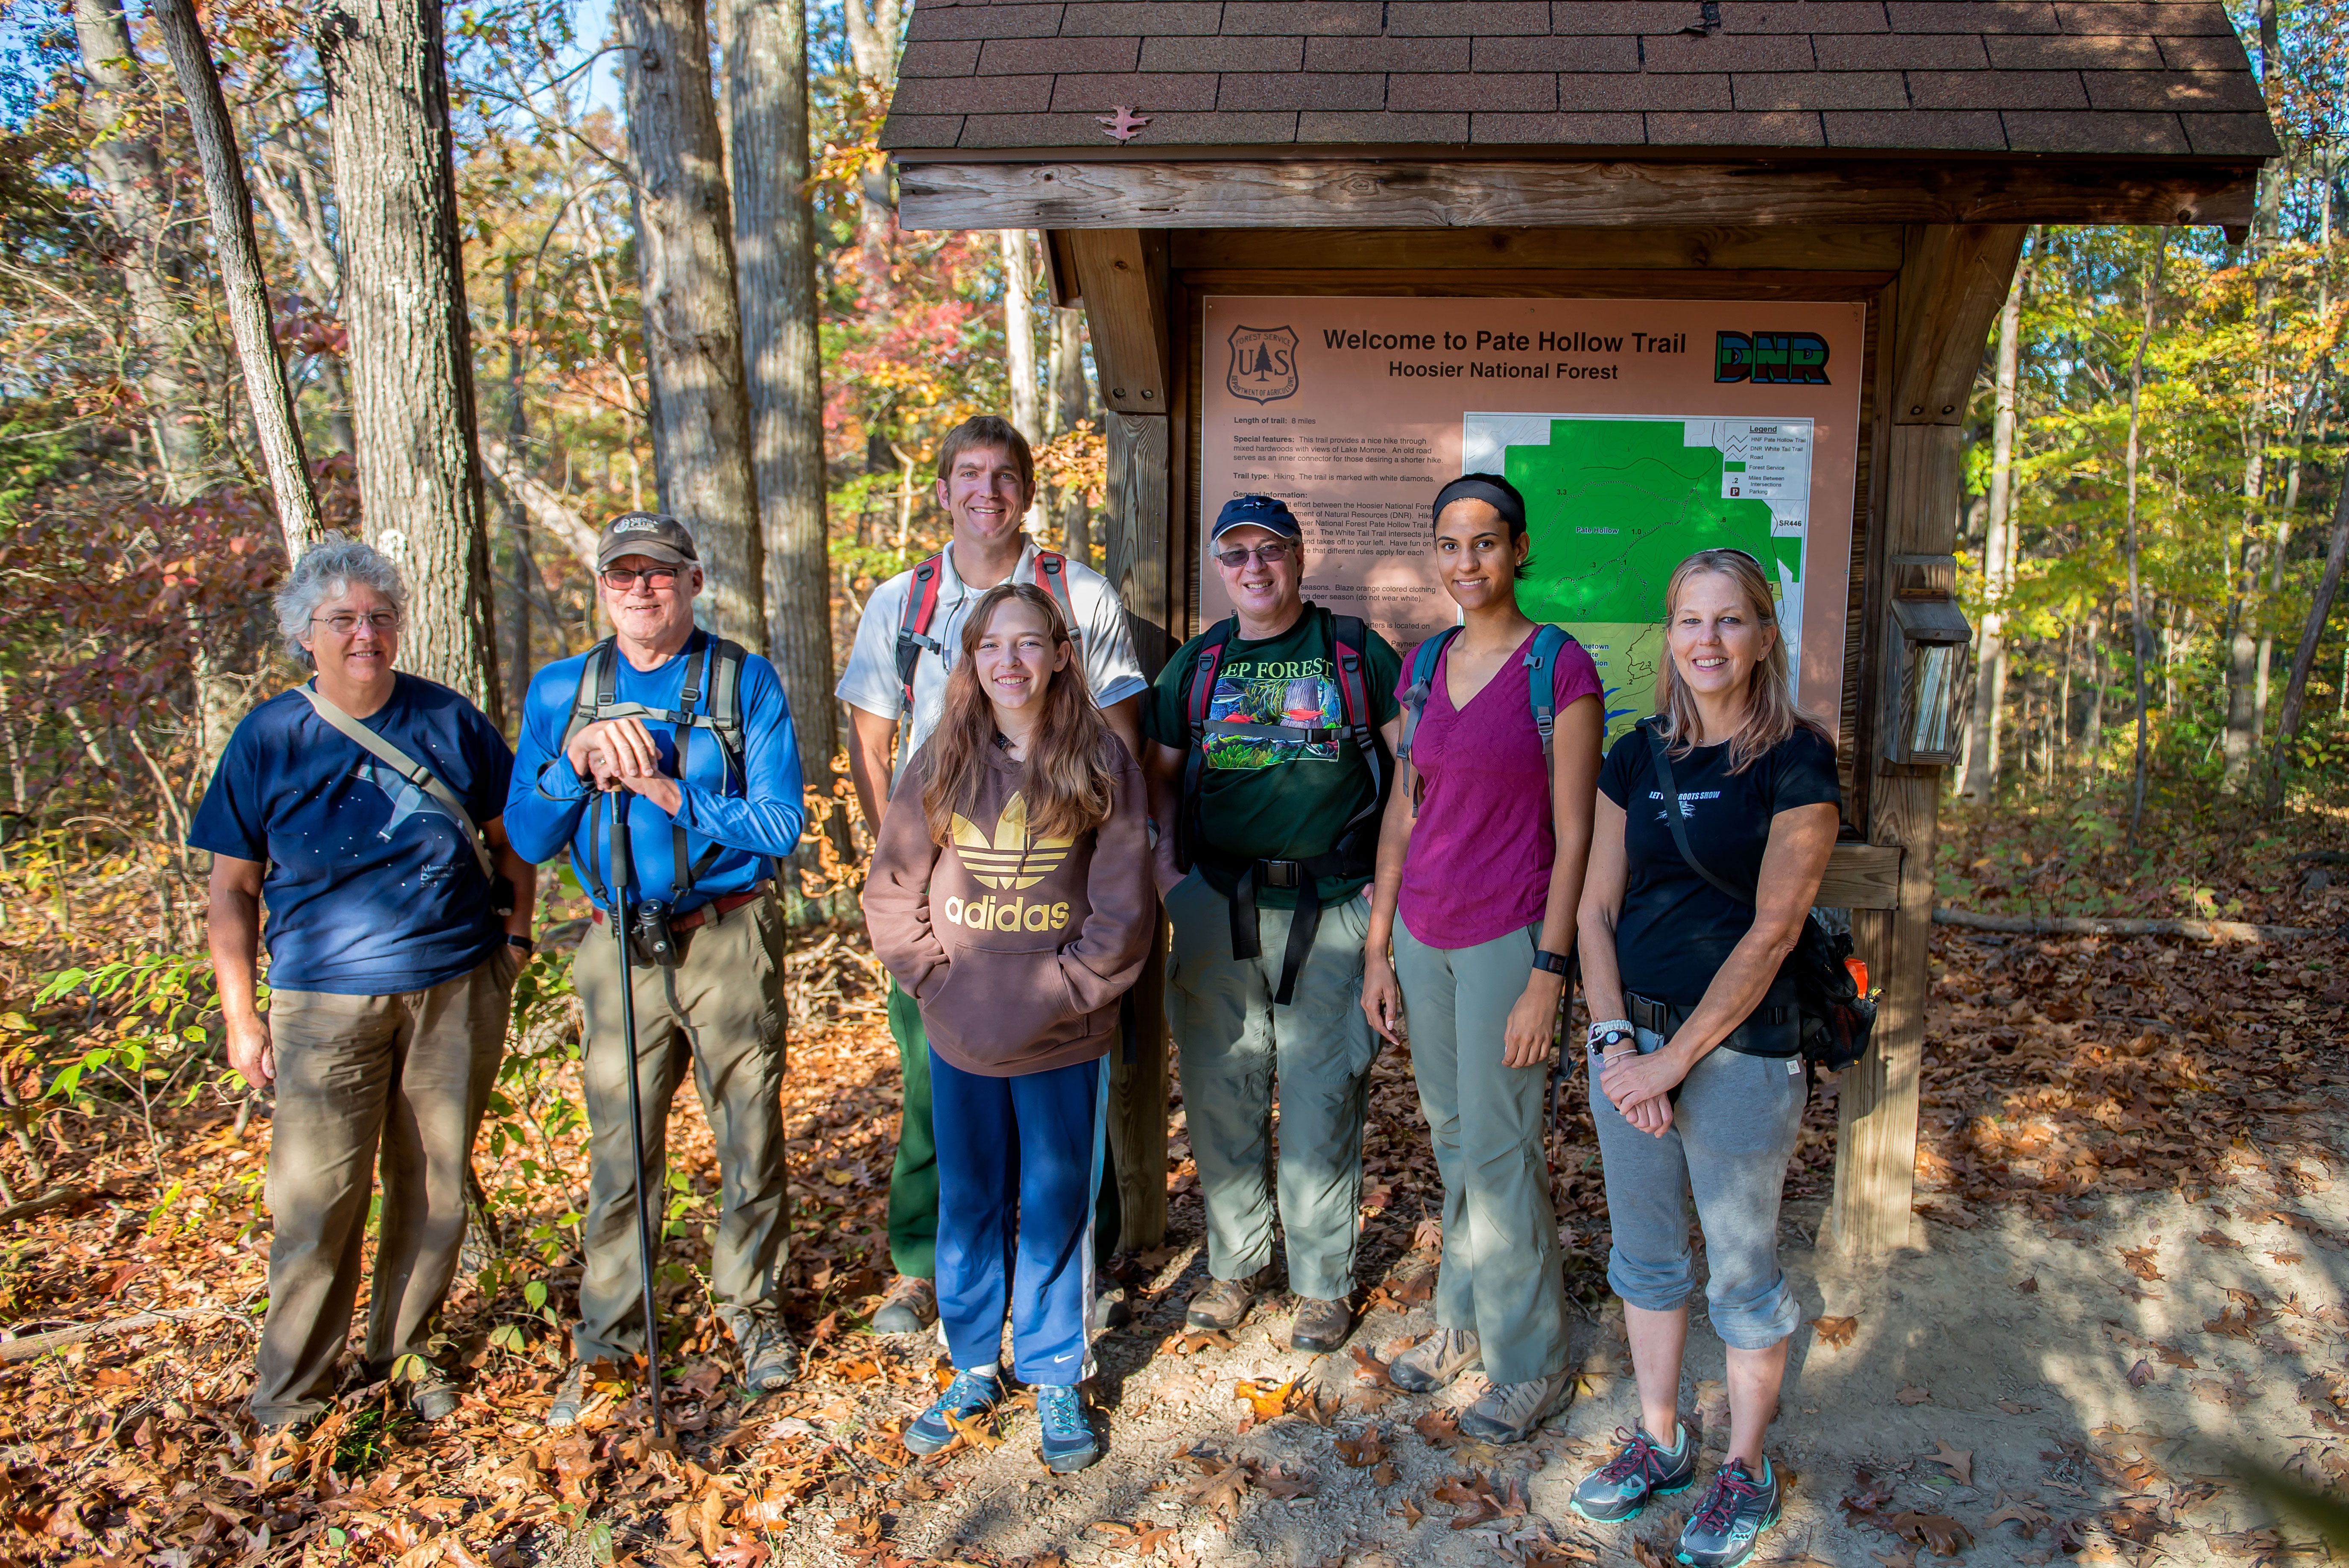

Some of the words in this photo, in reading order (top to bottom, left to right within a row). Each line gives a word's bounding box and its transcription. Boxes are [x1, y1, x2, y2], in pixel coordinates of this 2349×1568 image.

[1236, 333, 1261, 347] FOREST
[1264, 333, 1291, 347] SERVICE
[1323, 329, 1435, 350] Welcome
[1443, 331, 1467, 350] to
[1477, 331, 1530, 351] Pate
[1539, 331, 1624, 352] Hollow
[1632, 333, 1686, 353] Trail
[1239, 350, 1254, 375] U
[1275, 350, 1289, 376] S
[1714, 331, 1832, 385] DNR
[1390, 361, 1464, 377] Hoosier
[1470, 362, 1549, 378] National
[1556, 363, 1618, 380] Forest
[1232, 375, 1258, 396] DEPARTMENT
[1267, 376, 1294, 396] AGRICULTURE
[1409, 586, 1436, 594] clothing
[1256, 658, 1333, 678] FOREST
[1649, 791, 1661, 799] LET
[1678, 792, 1700, 800] ROOTS
[1700, 791, 1720, 799] SHOW
[945, 895, 1070, 932] adidas
